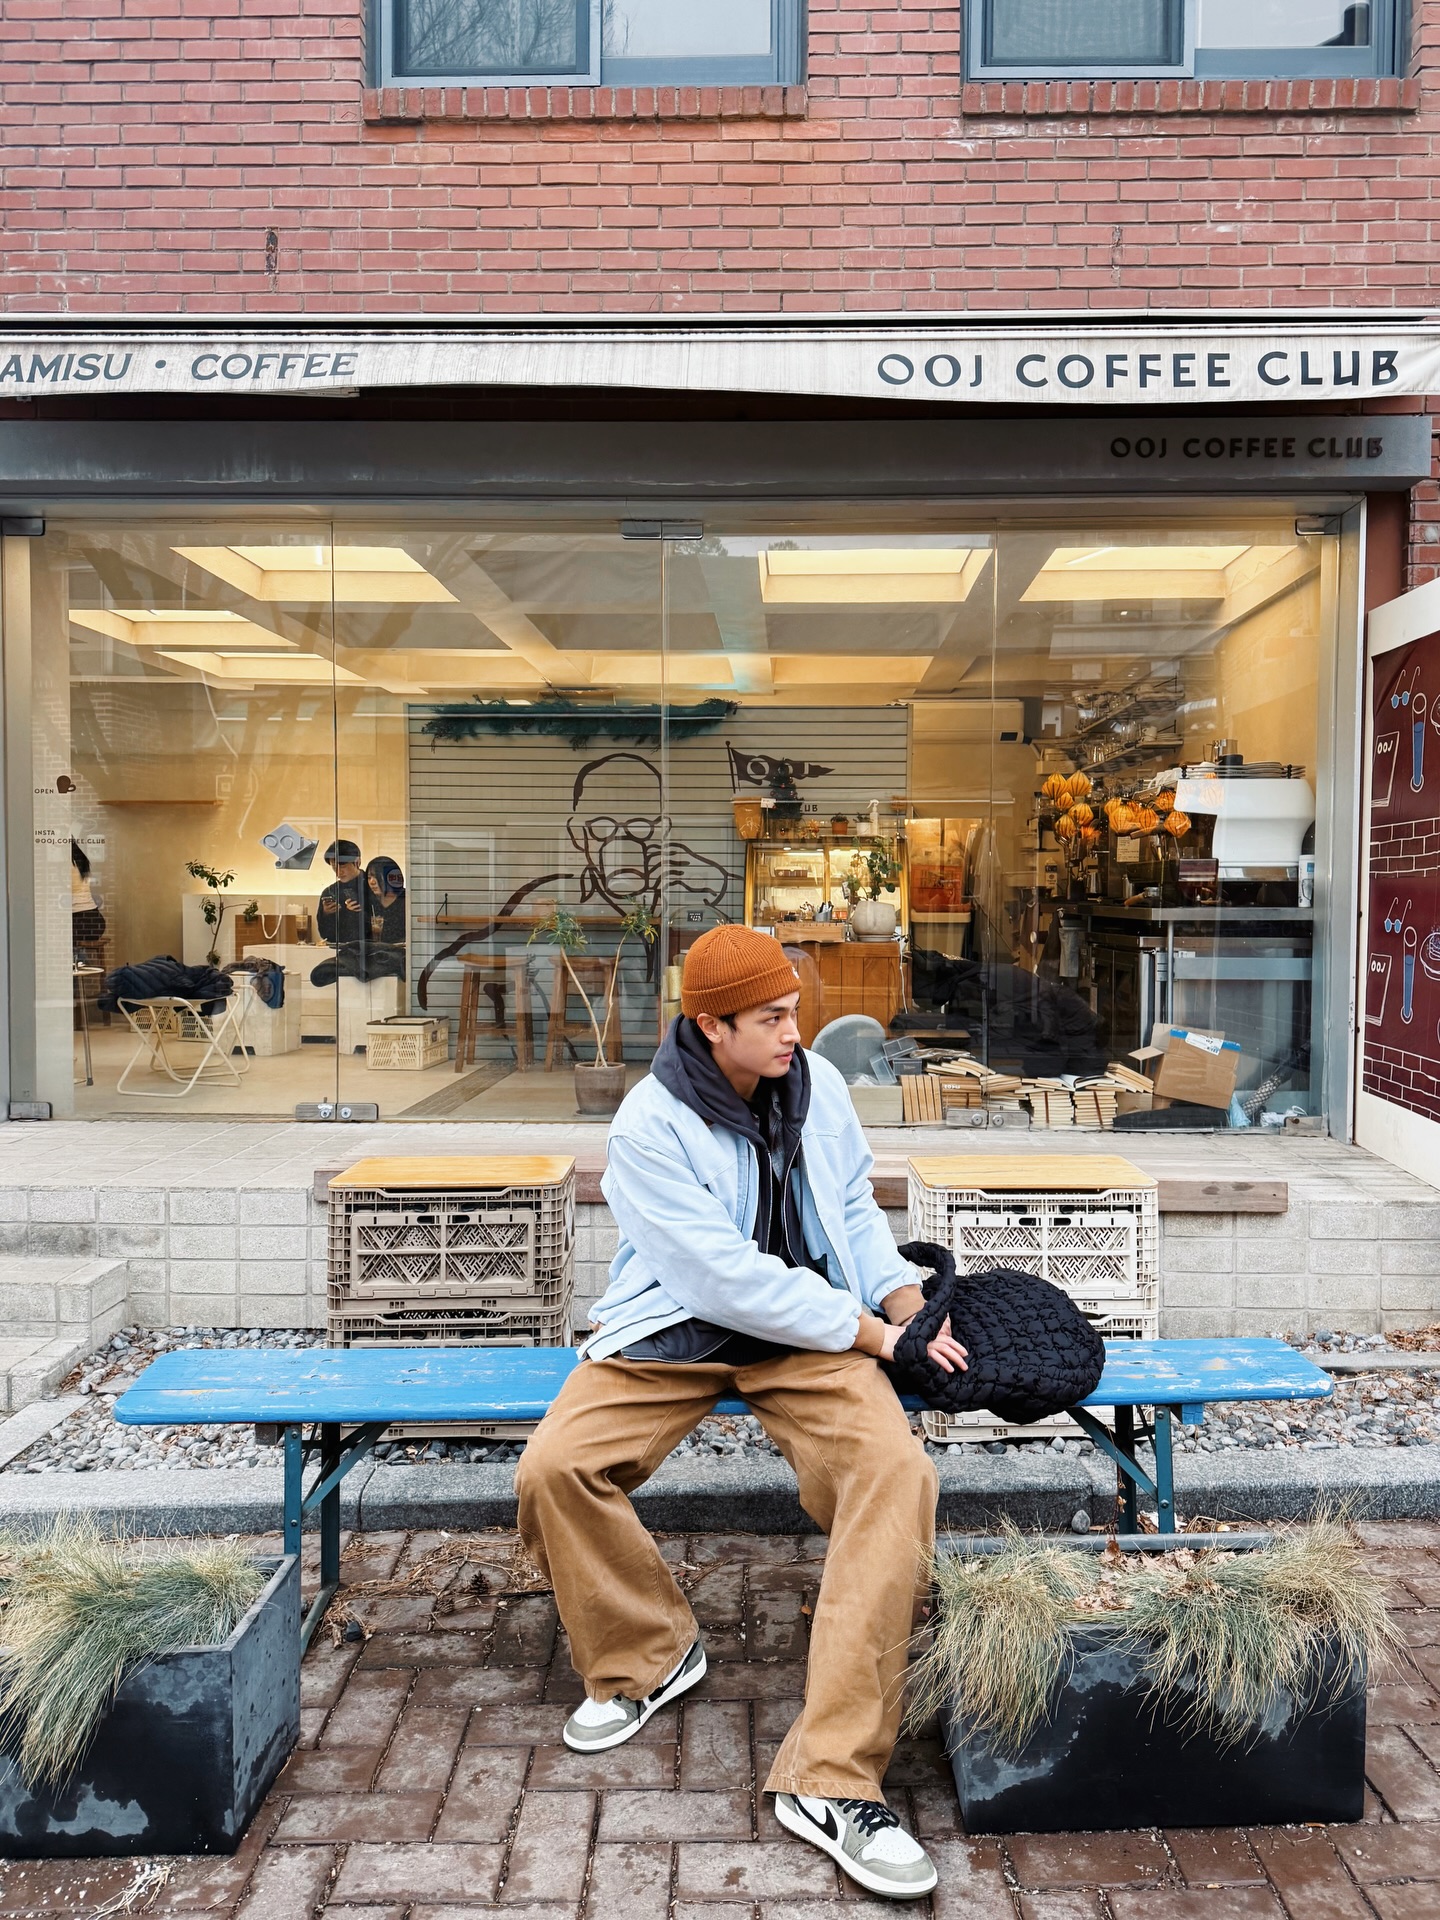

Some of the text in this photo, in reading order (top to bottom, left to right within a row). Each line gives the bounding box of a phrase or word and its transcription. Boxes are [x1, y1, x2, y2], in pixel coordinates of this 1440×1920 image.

[0, 352, 359, 383] AMISU COFFEE
[877, 350, 1399, 389] OOJ COFFEE CLUB
[1110, 437, 1384, 459] OOJ COFFEE CLUB
[1377, 740, 1393, 755] OOJ
[263, 834, 305, 851] OOJ
[1370, 960, 1386, 973] OOJ
